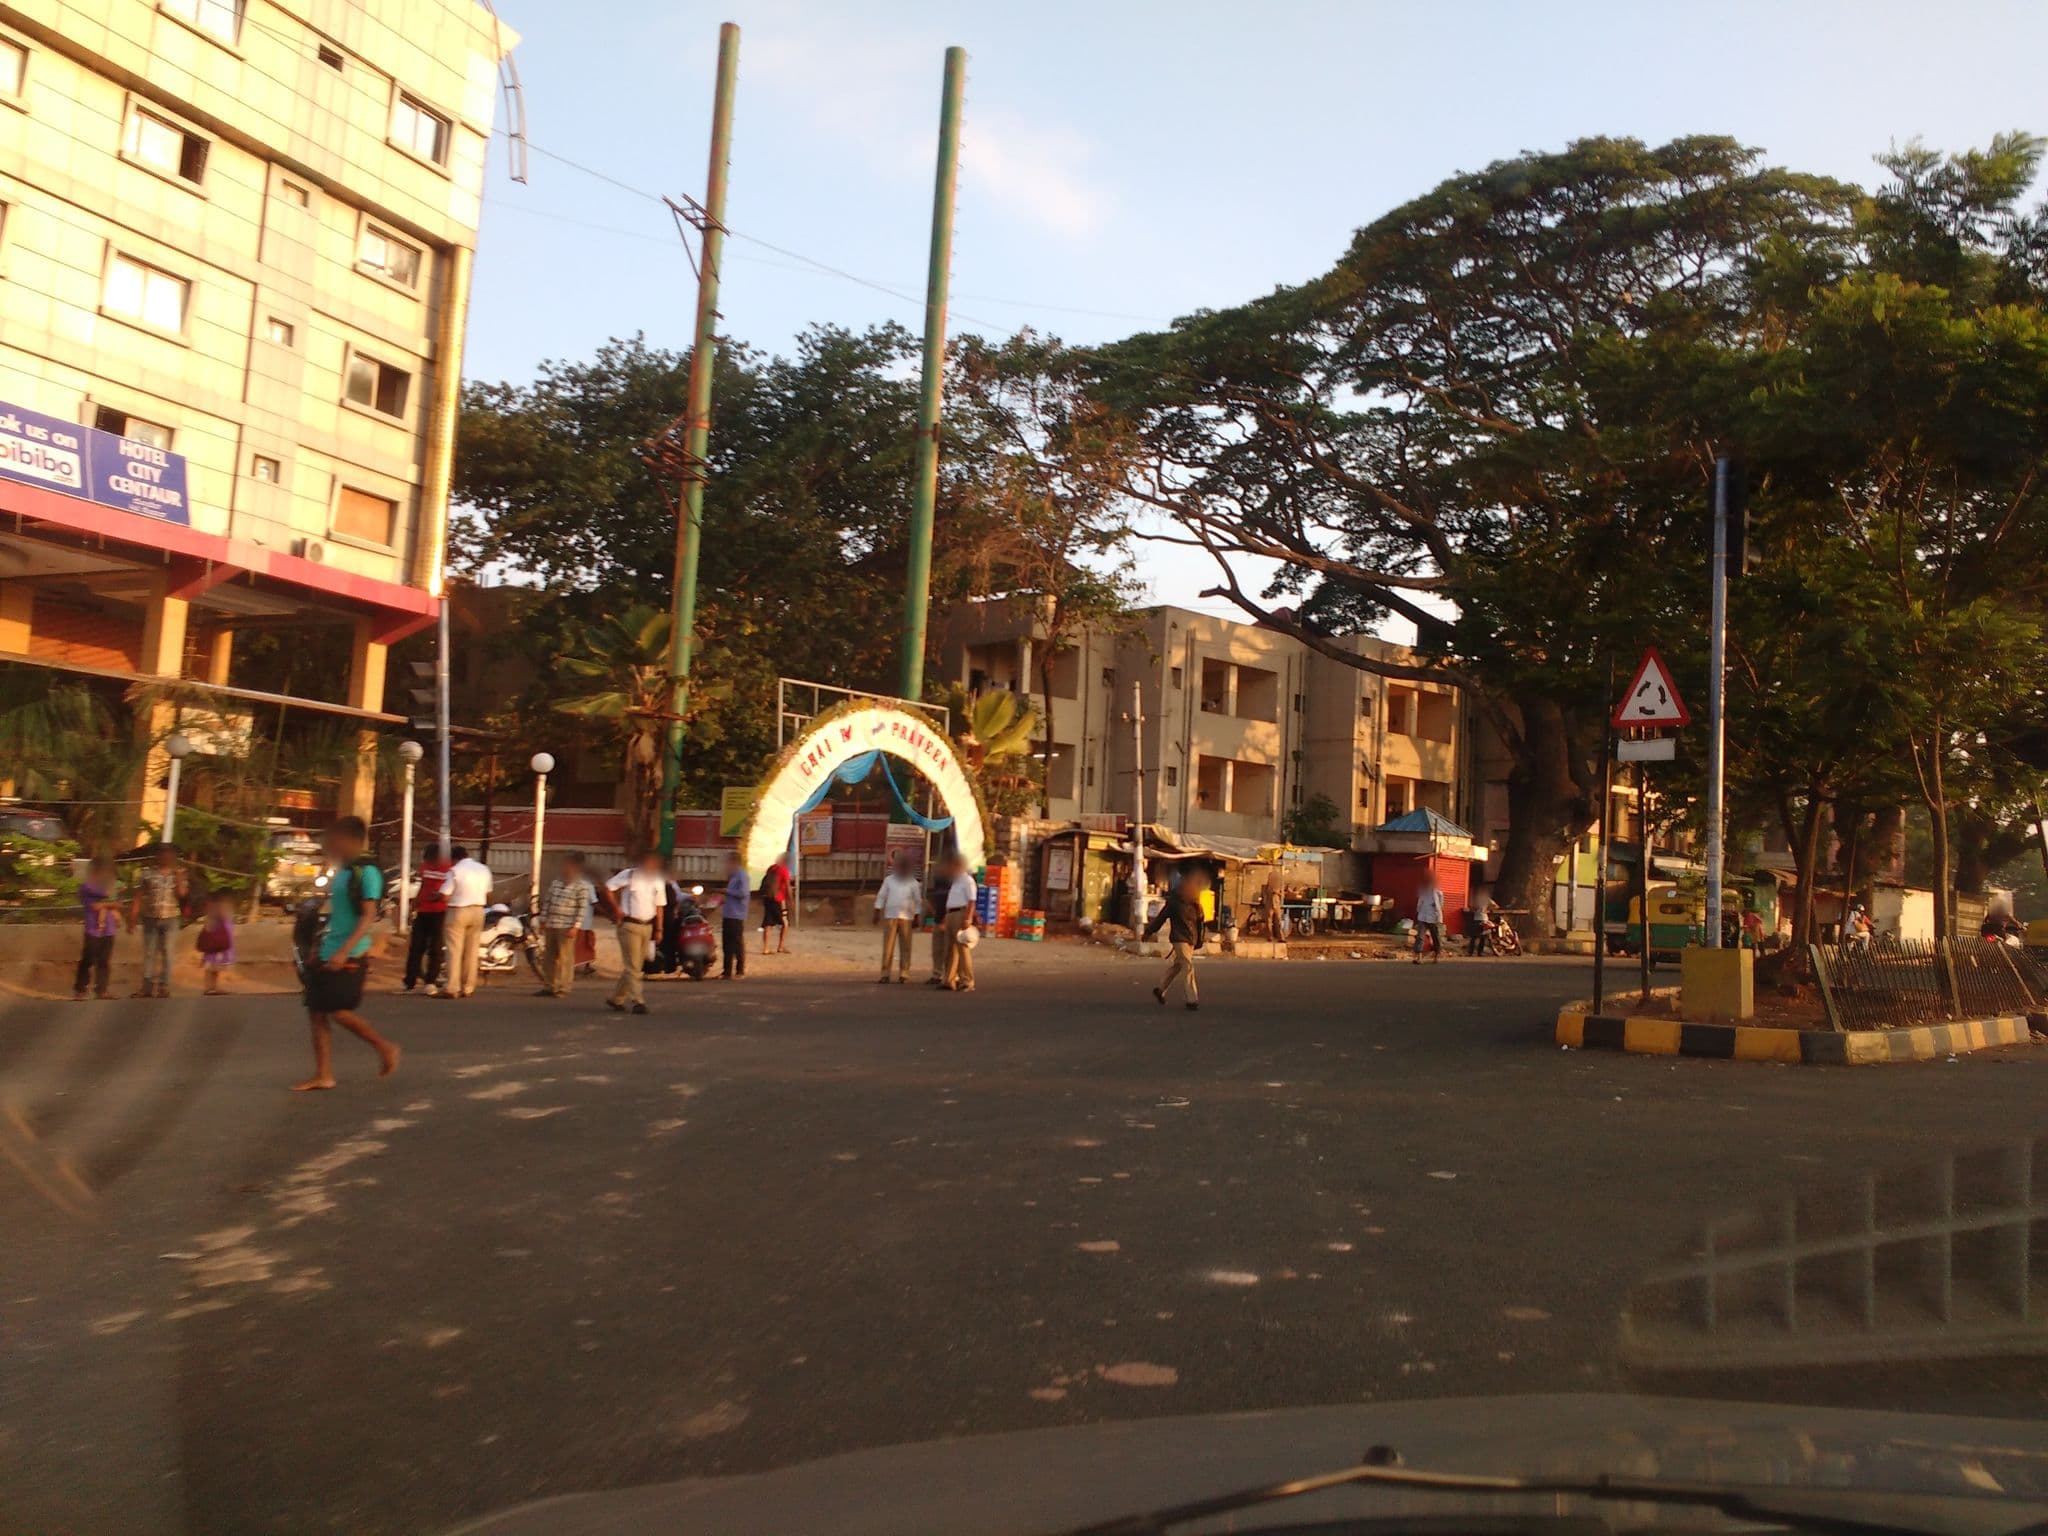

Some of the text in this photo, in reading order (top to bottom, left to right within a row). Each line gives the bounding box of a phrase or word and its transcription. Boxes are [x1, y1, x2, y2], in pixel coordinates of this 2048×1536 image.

[25, 423, 48, 441] us
[51, 432, 78, 449] on
[119, 439, 170, 468] HOTEL
[127, 461, 162, 483] CITY
[108, 474, 182, 507] CENTAUR
